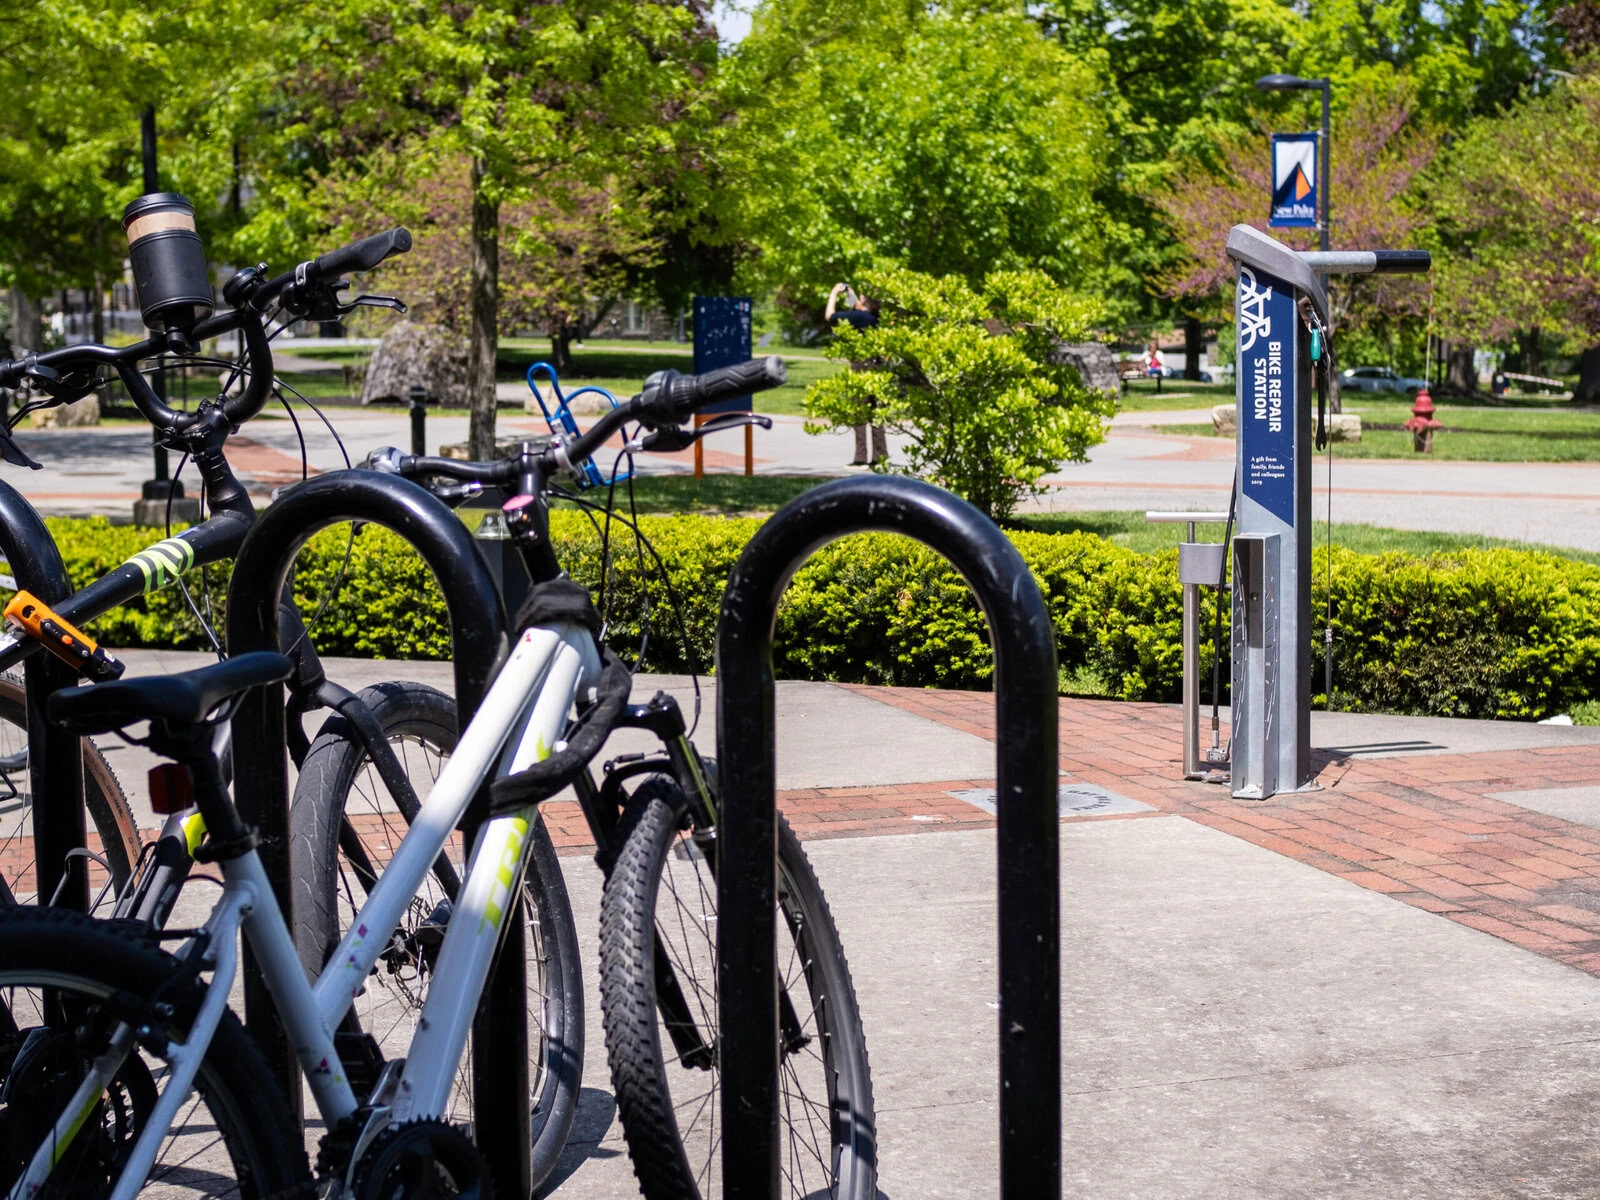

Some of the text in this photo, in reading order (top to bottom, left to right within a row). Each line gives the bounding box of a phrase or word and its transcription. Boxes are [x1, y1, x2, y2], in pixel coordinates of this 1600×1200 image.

[1254, 358, 1267, 420] STATION
[1268, 341, 1282, 433] BIKE REPAIR
